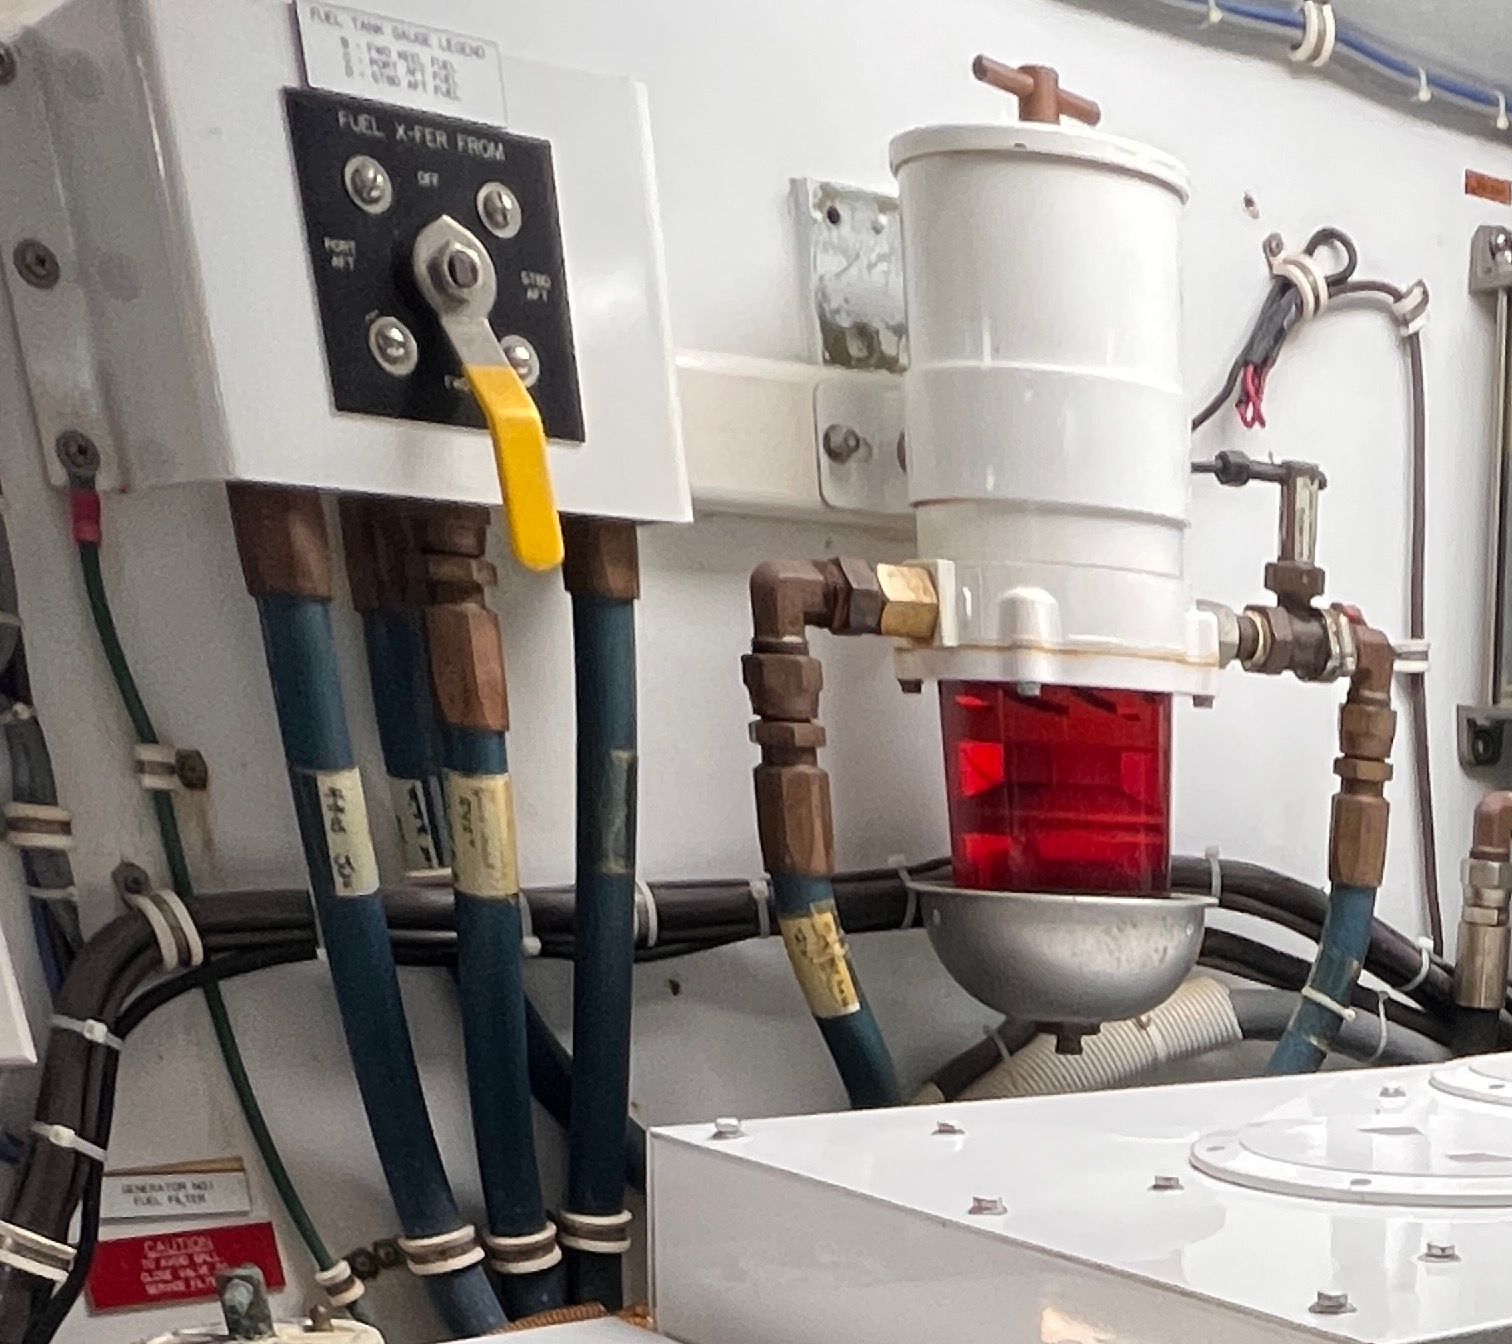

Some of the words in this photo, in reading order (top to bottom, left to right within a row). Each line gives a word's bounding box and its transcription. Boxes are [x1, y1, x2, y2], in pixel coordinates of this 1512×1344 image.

[337, 111, 385, 138] FUEL
[395, 122, 449, 151] X-FER
[457, 133, 507, 161] FROM
[417, 170, 440, 187] OFF
[323, 236, 356, 258] PORT
[330, 254, 355, 272] AFT
[520, 270, 552, 289] STBD
[526, 286, 549, 304] AFT
[121, 1180, 187, 1195] GENERATOR
[133, 1194, 163, 1207] FUEL
[168, 1193, 207, 1208] FILTER
[144, 1234, 216, 1256] CAUTION
